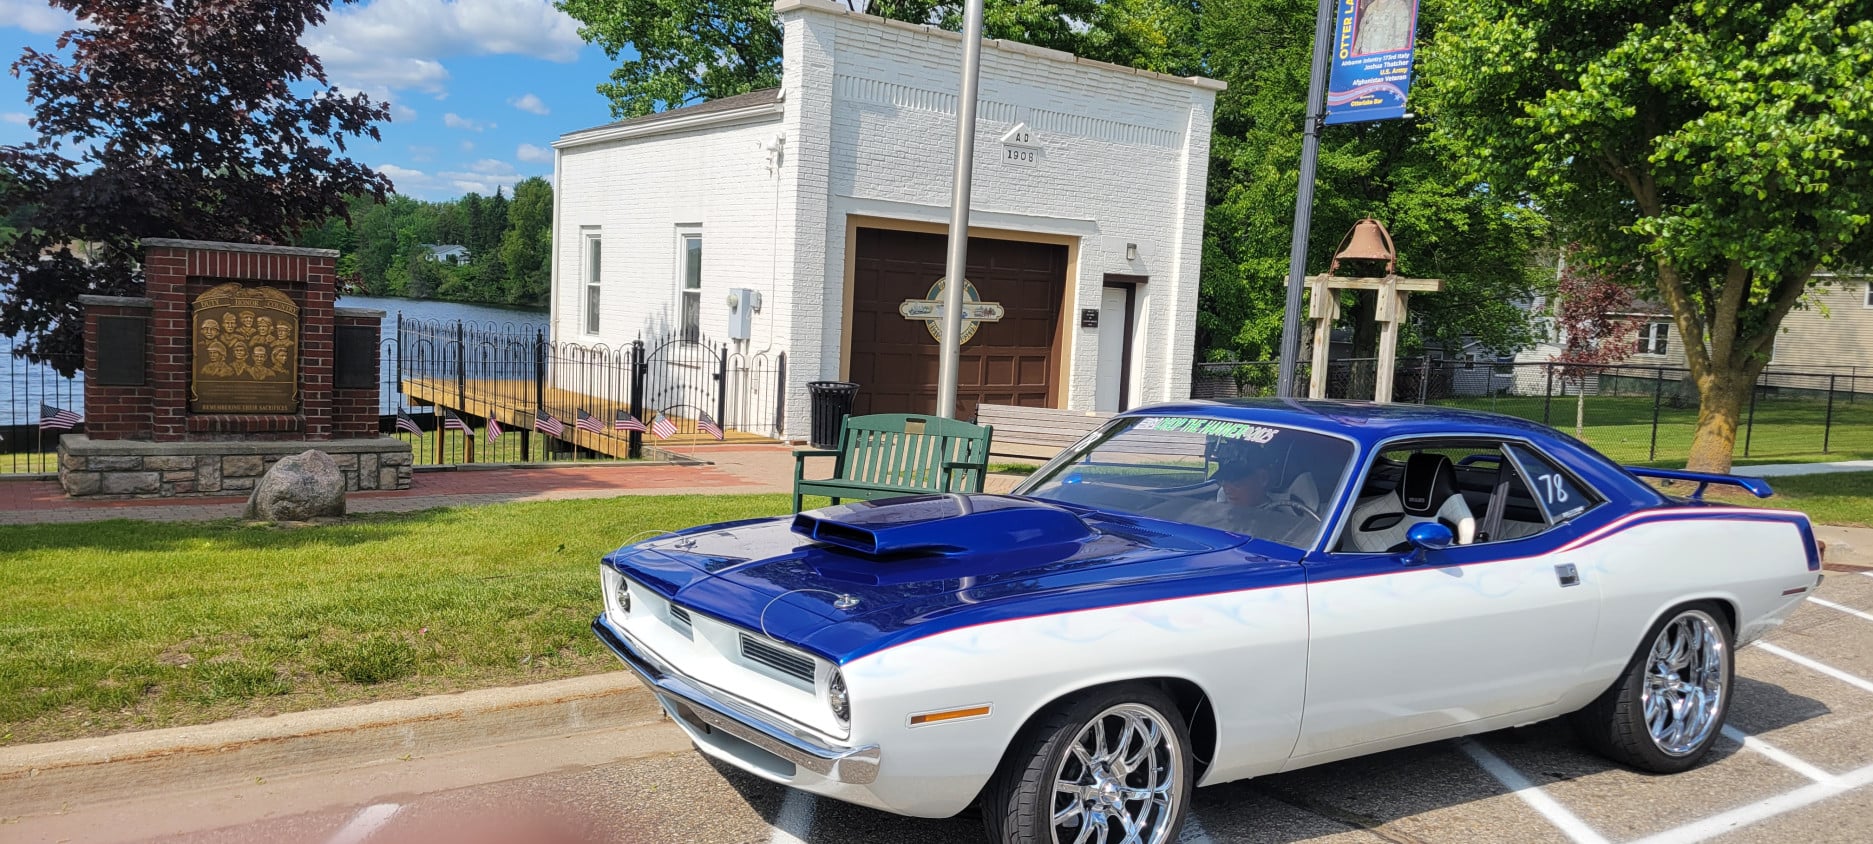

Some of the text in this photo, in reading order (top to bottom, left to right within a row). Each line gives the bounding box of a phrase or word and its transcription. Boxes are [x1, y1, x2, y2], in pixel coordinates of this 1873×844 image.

[1340, 17, 1353, 59] OTTER
[1384, 60, 1409, 68] Thatcher
[1352, 77, 1384, 86] Afghanistan
[200, 299, 298, 313] DUTY HONOR COUNTRY
[1154, 417, 1188, 431] DROP
[1180, 418, 1208, 433] THE
[1199, 420, 1249, 440] HAMMER
[1538, 473, 1568, 504] 78
